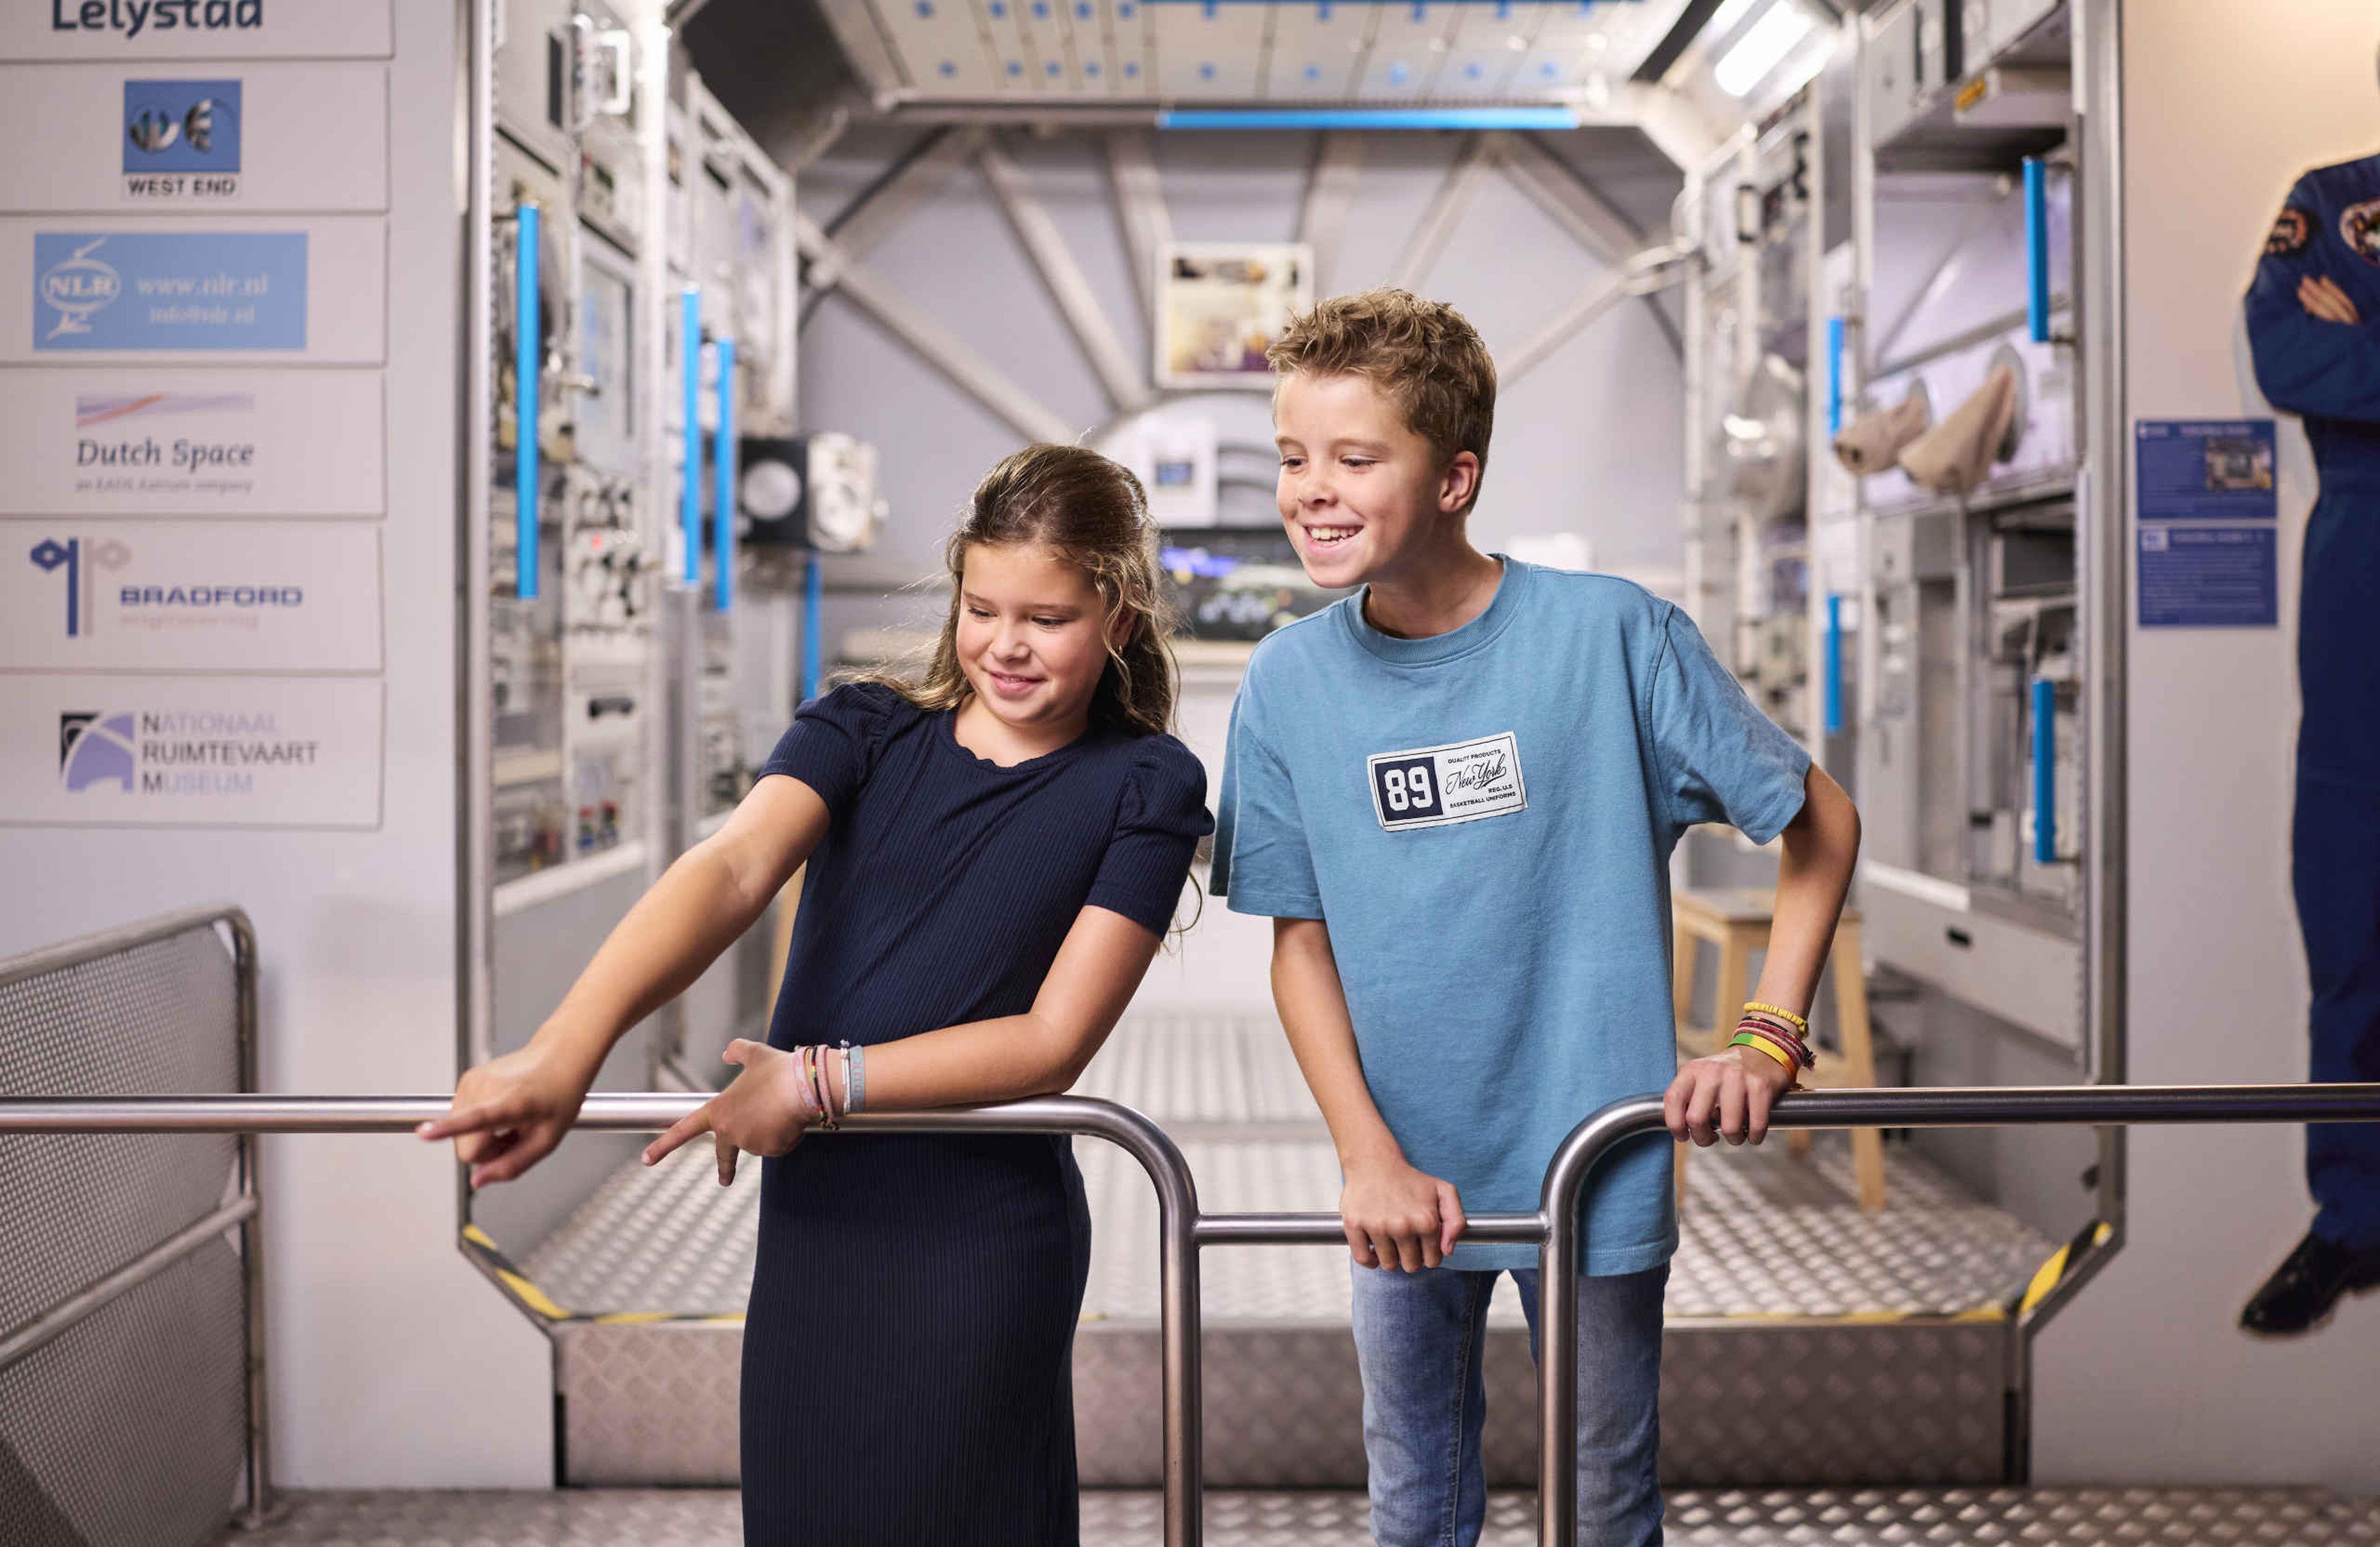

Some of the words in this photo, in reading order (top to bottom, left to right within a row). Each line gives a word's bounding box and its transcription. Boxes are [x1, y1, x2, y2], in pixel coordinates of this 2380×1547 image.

[52, 0, 263, 38] Lelystad
[128, 178, 184, 195] WEST
[193, 178, 236, 195] END
[49, 275, 113, 297] NLR
[138, 273, 268, 294] www.nlr.nl
[77, 436, 161, 465] Dutch
[172, 438, 255, 473] Space
[120, 586, 302, 606] BRADFORD
[143, 712, 278, 733] NATIONAAL
[143, 741, 318, 764] RUIMTEVAART
[1448, 755, 1470, 764] QUALITY
[1471, 749, 1501, 759] PRODUCTS
[143, 772, 253, 793] MUSEUM
[1445, 764, 1476, 795] New
[1471, 753, 1507, 790] York
[1384, 766, 1434, 811] 89
[1450, 798, 1485, 808] BASKETBALL
[1486, 791, 1516, 802] UNIFORMS
